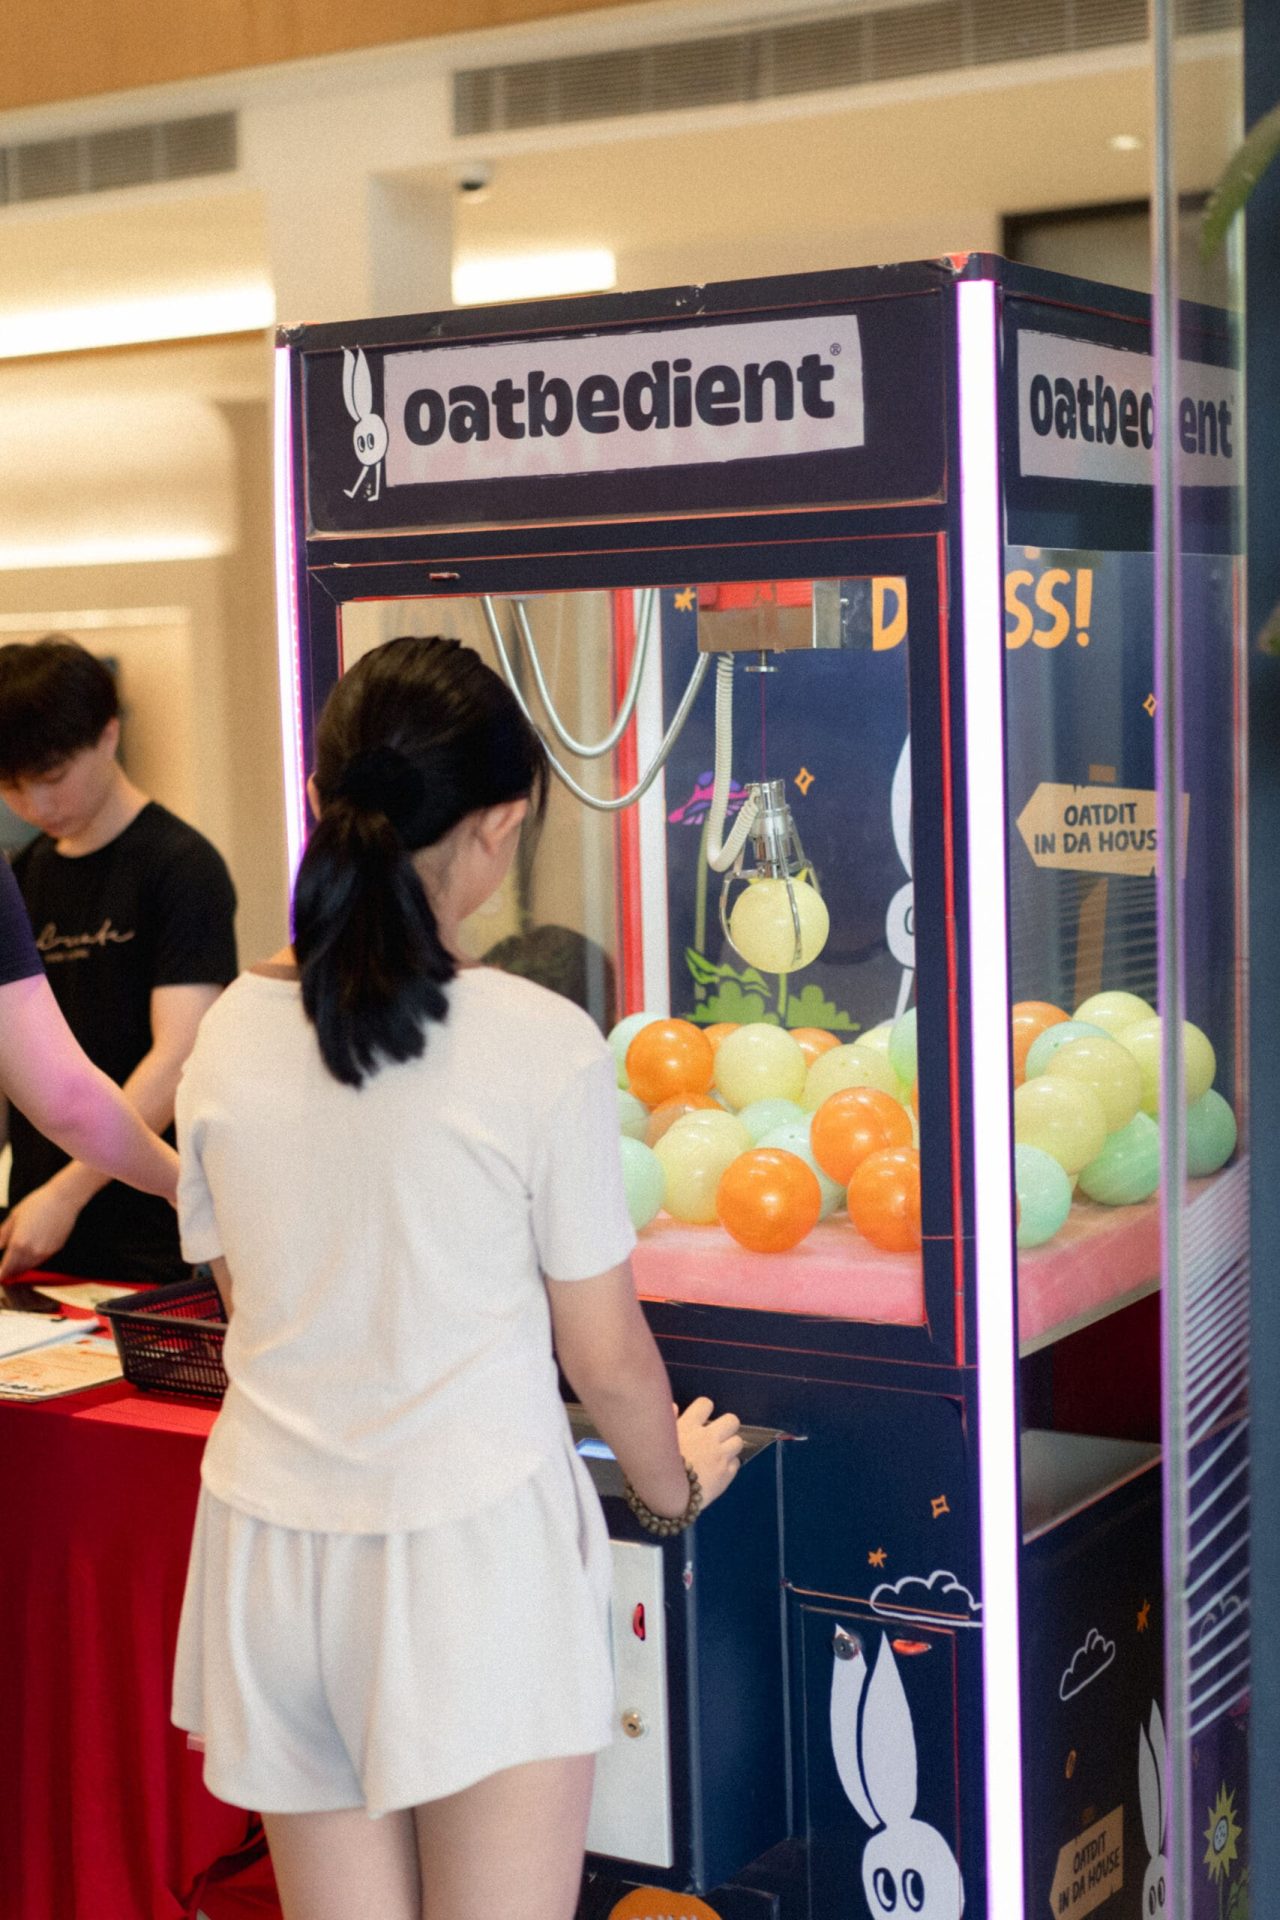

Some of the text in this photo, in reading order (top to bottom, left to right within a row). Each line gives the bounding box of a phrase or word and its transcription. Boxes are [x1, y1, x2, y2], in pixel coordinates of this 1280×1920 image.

[1030, 373, 1233, 459] oatbeent
[1064, 803, 1138, 827] OATDIT
[1034, 829, 1158, 854] IN DA HOUS
[1058, 1846, 1121, 1914] IN DA HOUSE
